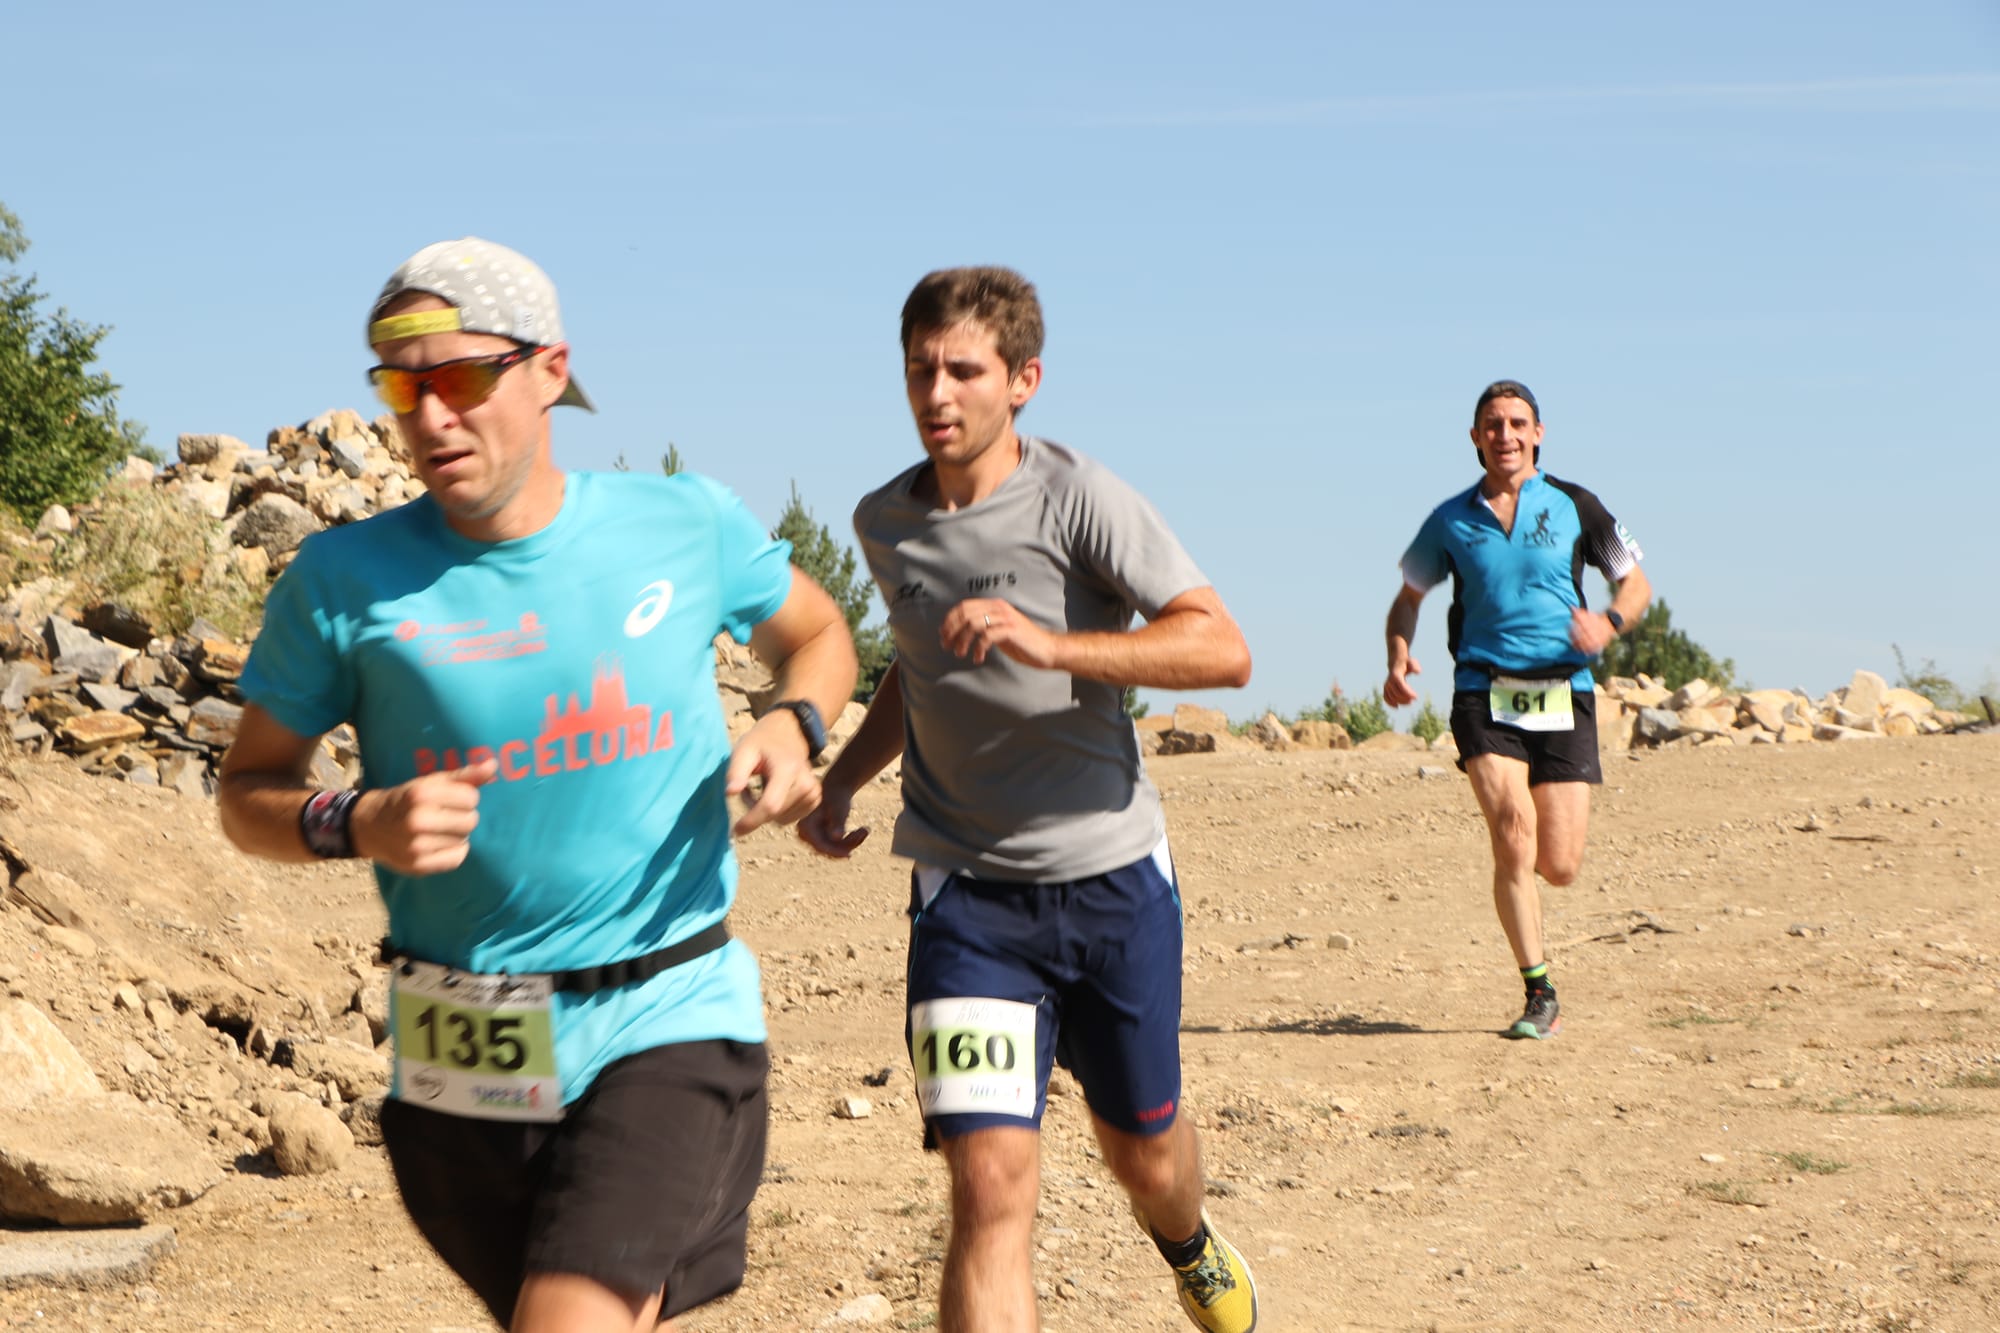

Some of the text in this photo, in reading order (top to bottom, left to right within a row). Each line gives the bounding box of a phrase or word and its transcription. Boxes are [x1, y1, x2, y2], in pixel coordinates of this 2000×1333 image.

[1512, 691, 1546, 713] 61
[416, 1004, 526, 1073] 135
[921, 1031, 1016, 1076] 160
